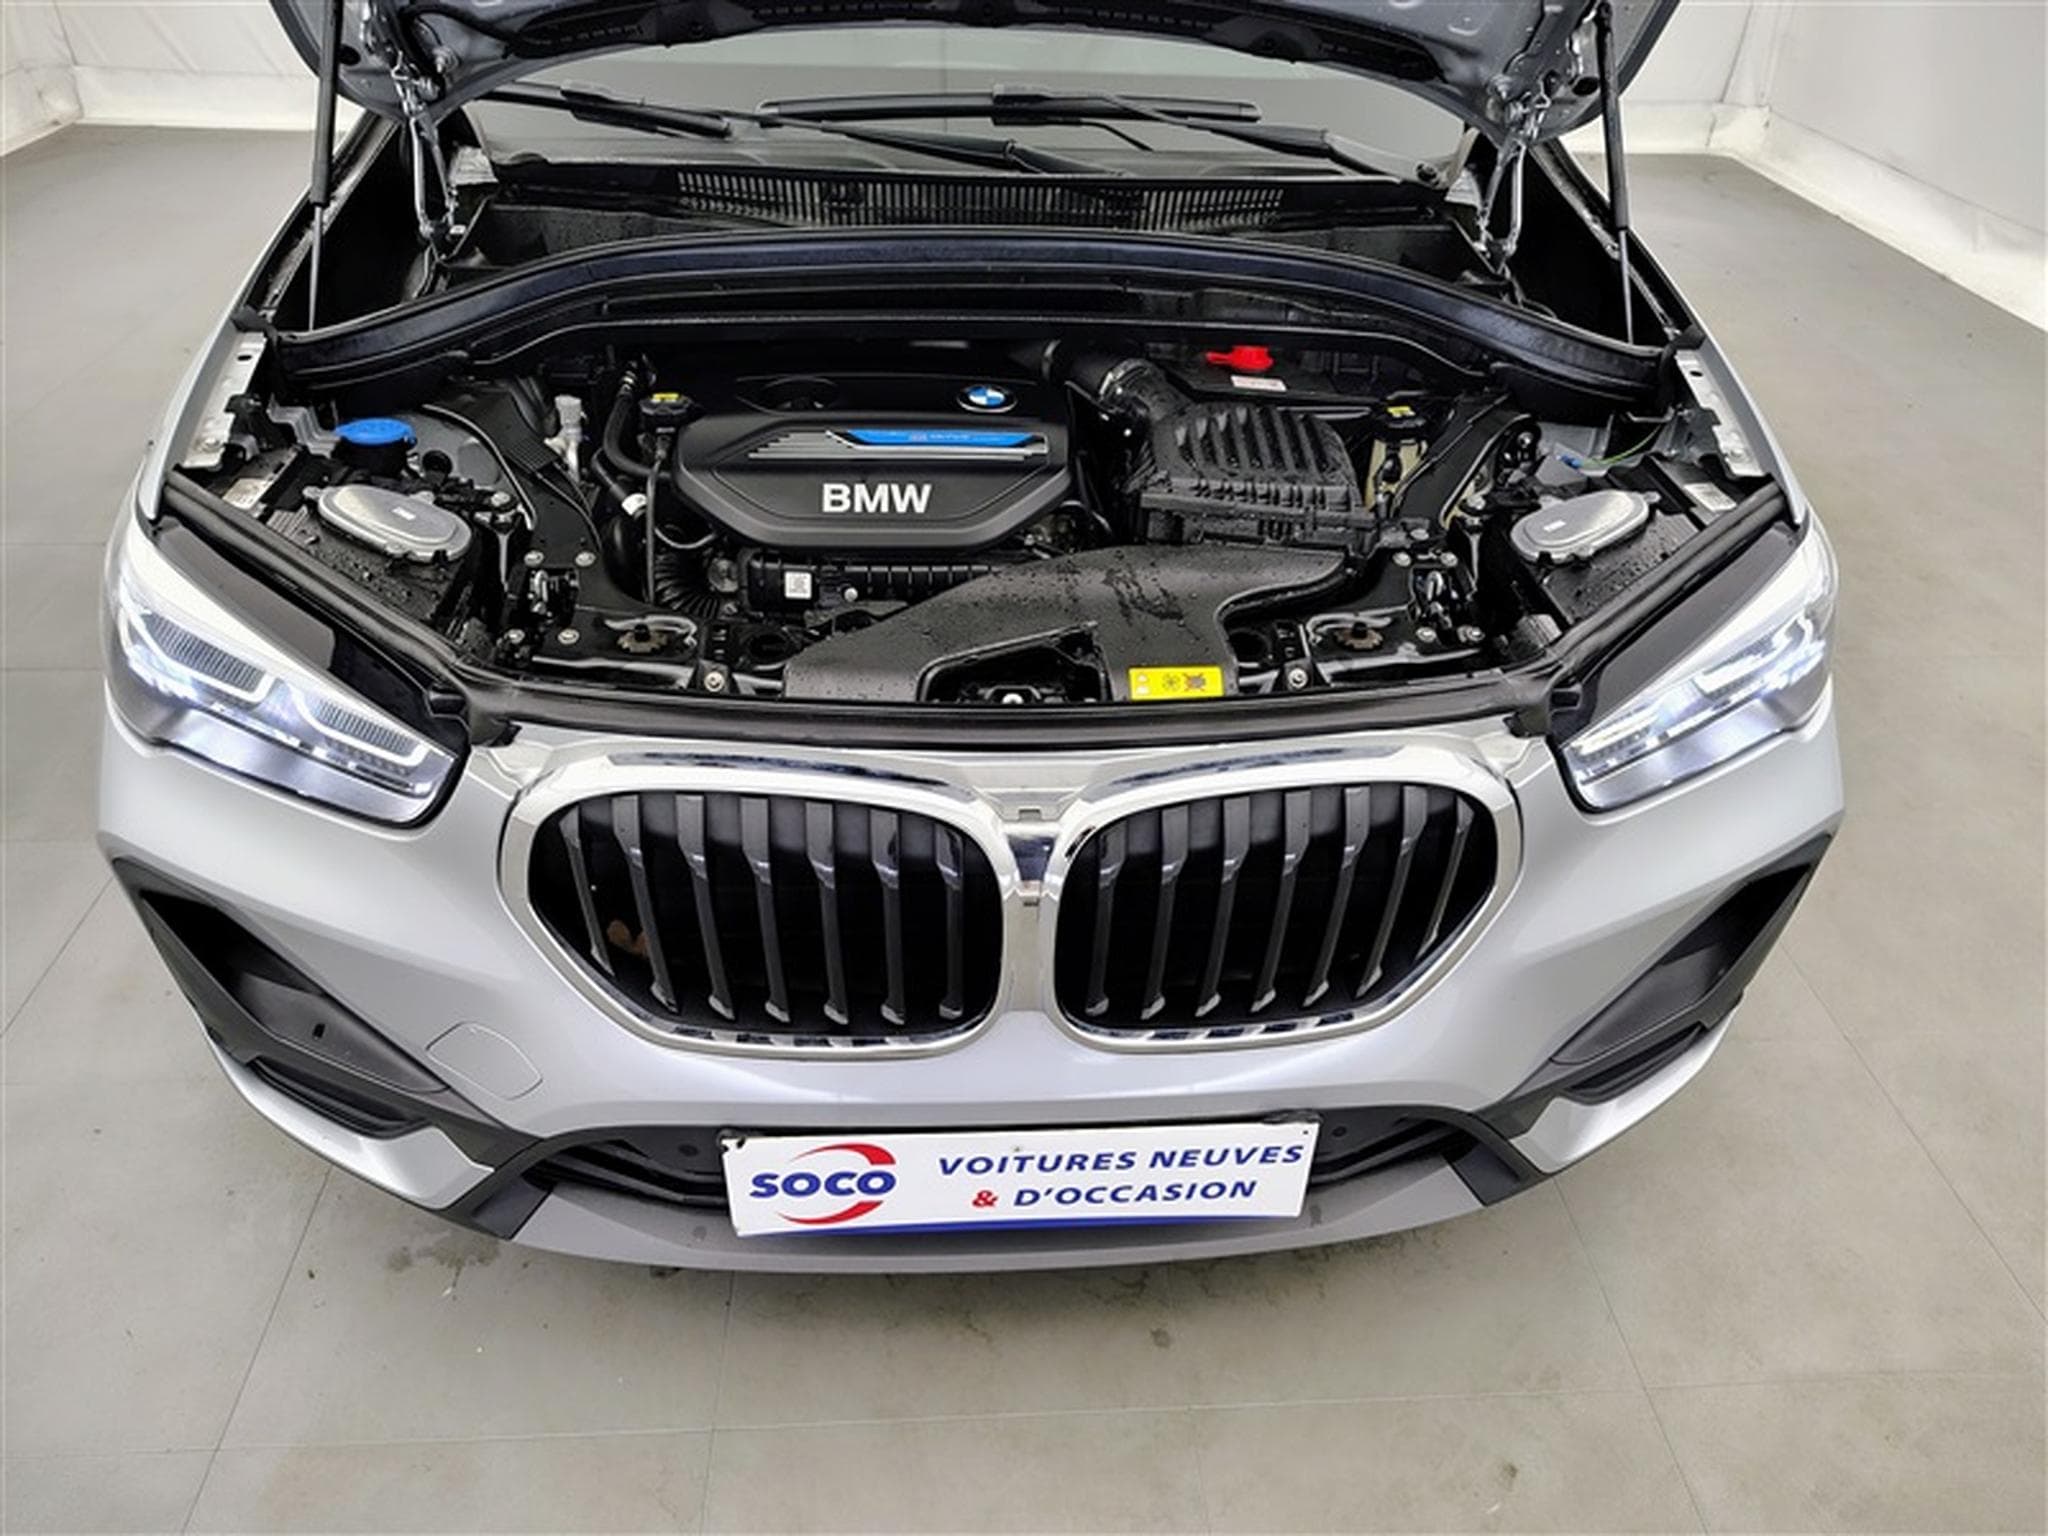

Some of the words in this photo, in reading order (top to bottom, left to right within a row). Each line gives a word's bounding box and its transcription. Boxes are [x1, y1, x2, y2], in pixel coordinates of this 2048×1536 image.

[821, 483, 932, 513] BMW
[939, 1151, 1137, 1176] VOITURES
[1149, 1144, 1304, 1169] NEUVES
[749, 1170, 897, 1198] SOCO
[971, 1190, 998, 1208] &
[1013, 1180, 1257, 1207] D'OCCASION
